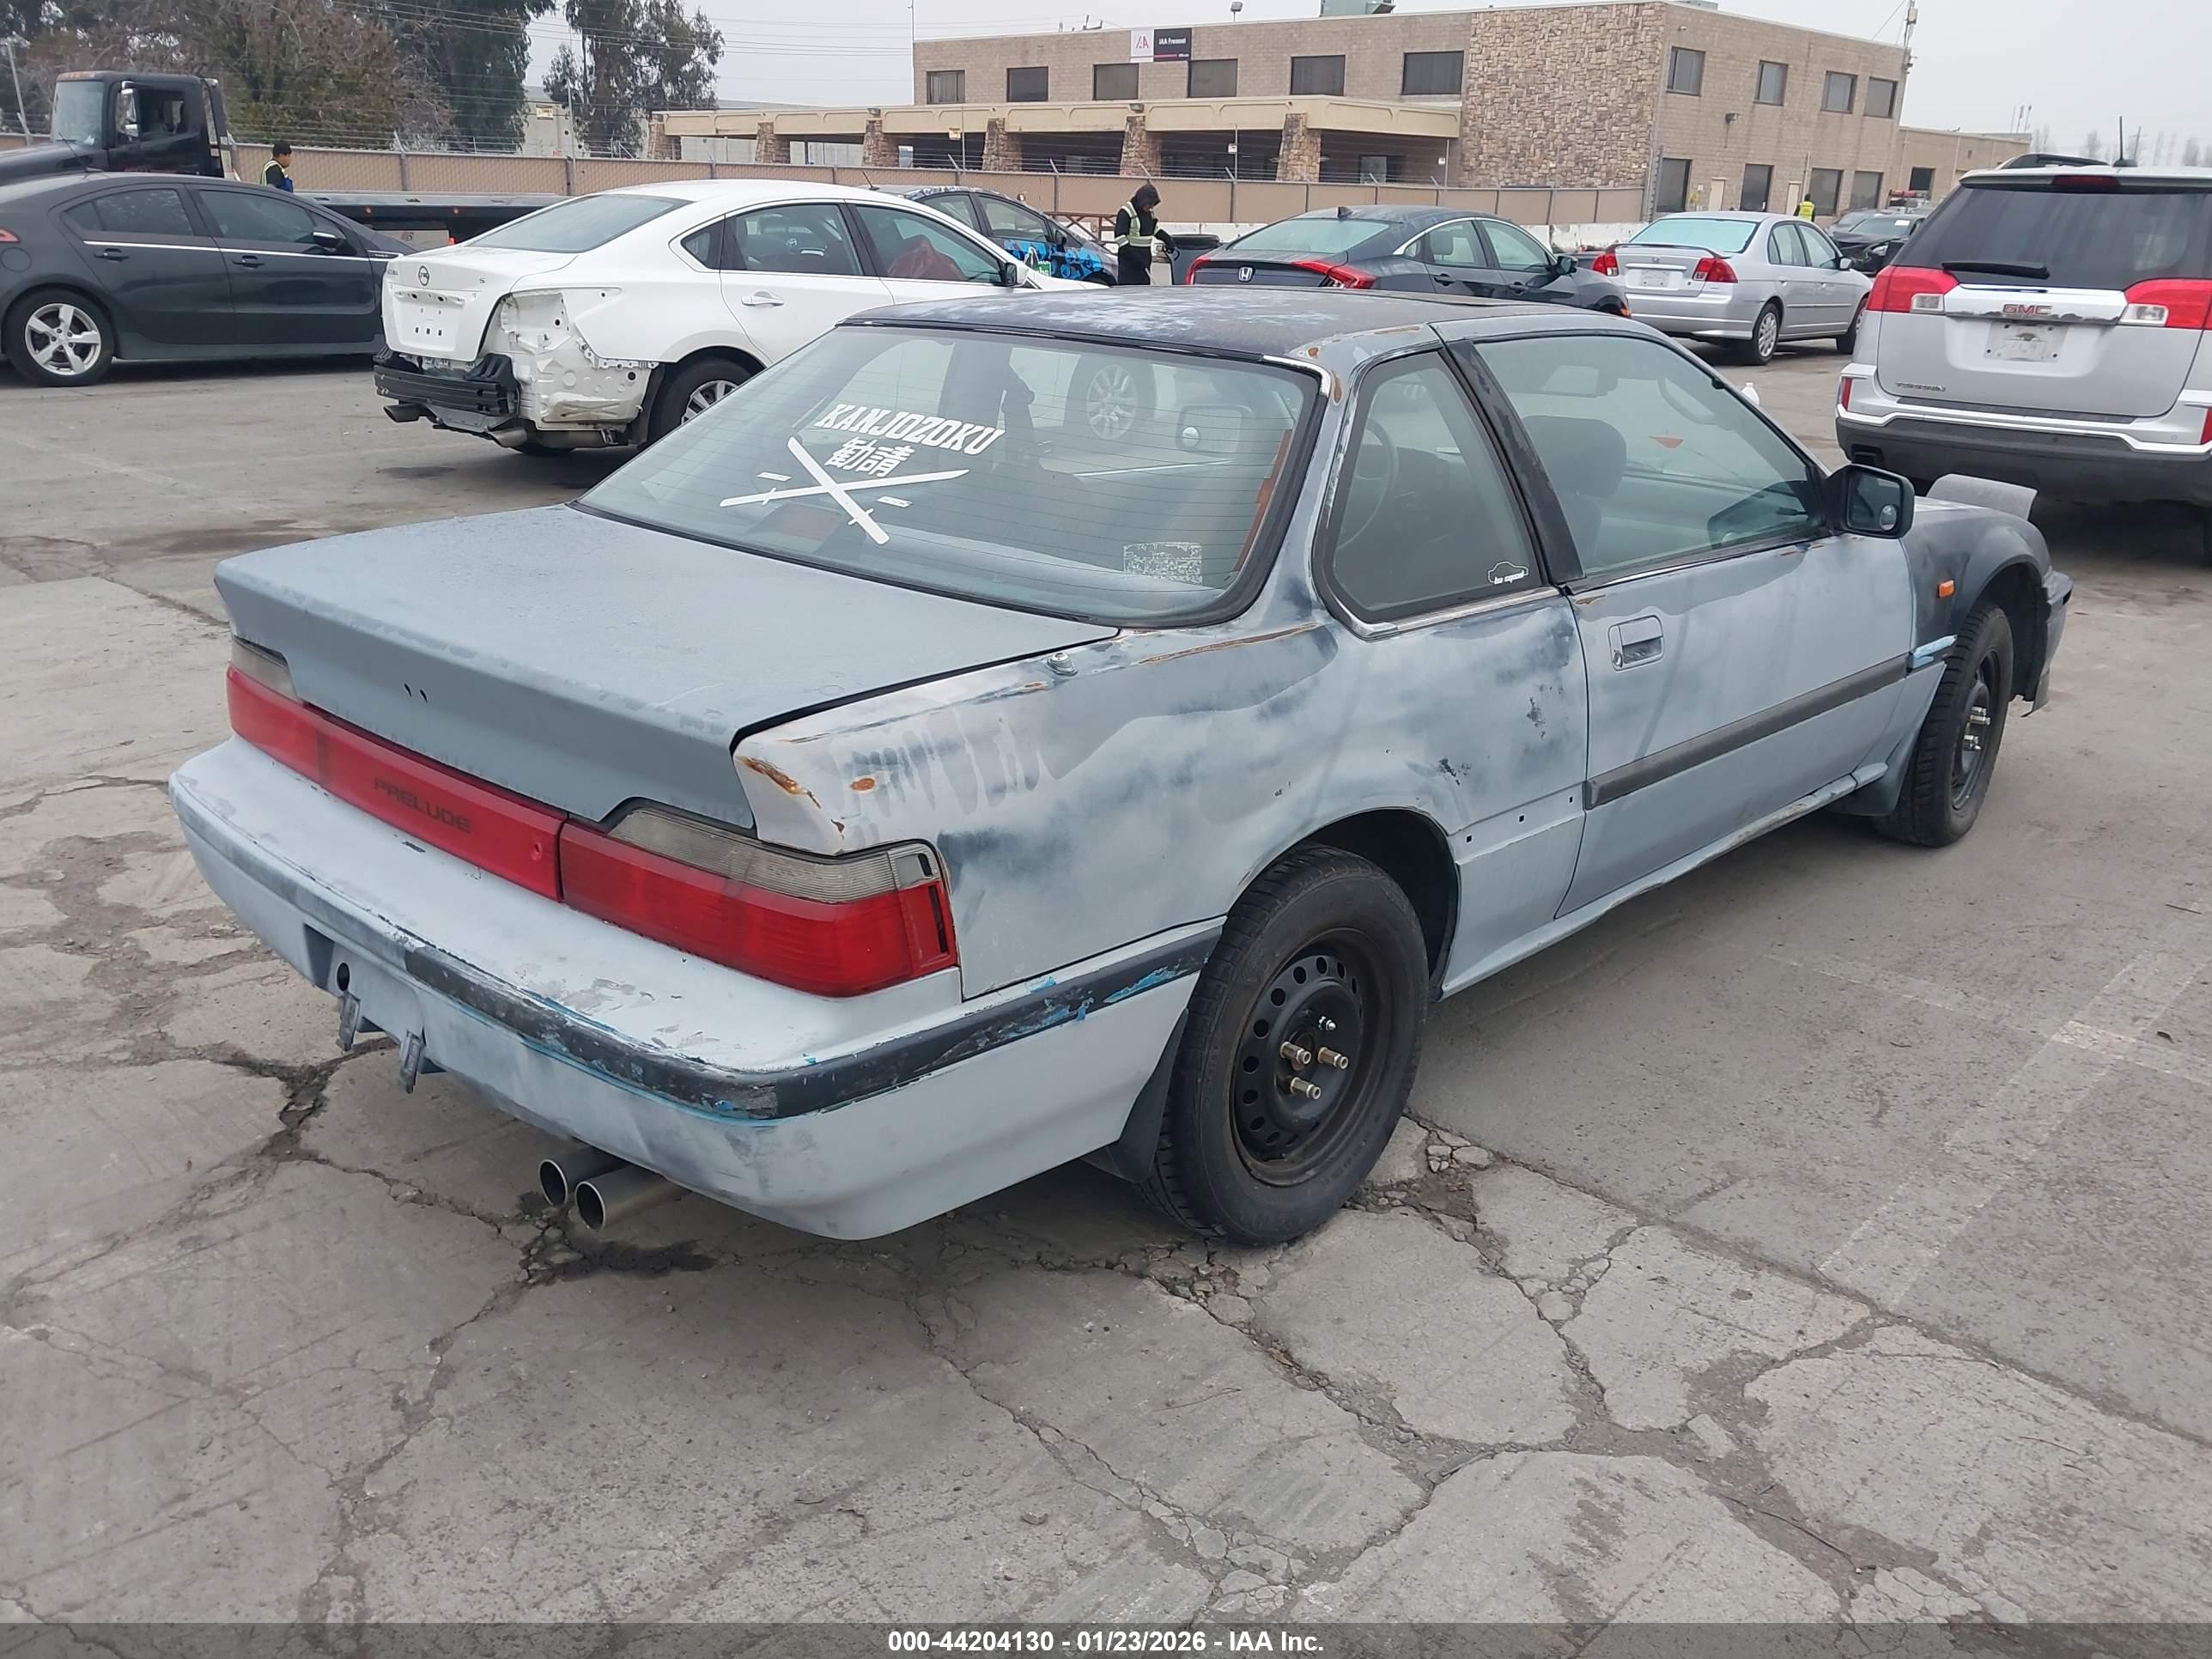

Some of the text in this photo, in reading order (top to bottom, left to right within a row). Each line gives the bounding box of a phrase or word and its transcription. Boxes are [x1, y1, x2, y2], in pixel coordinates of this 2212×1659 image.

[2002, 303, 2053, 316] GMC
[814, 404, 1006, 455] KANJOZOKU
[374, 776, 471, 834] PRELUDE
